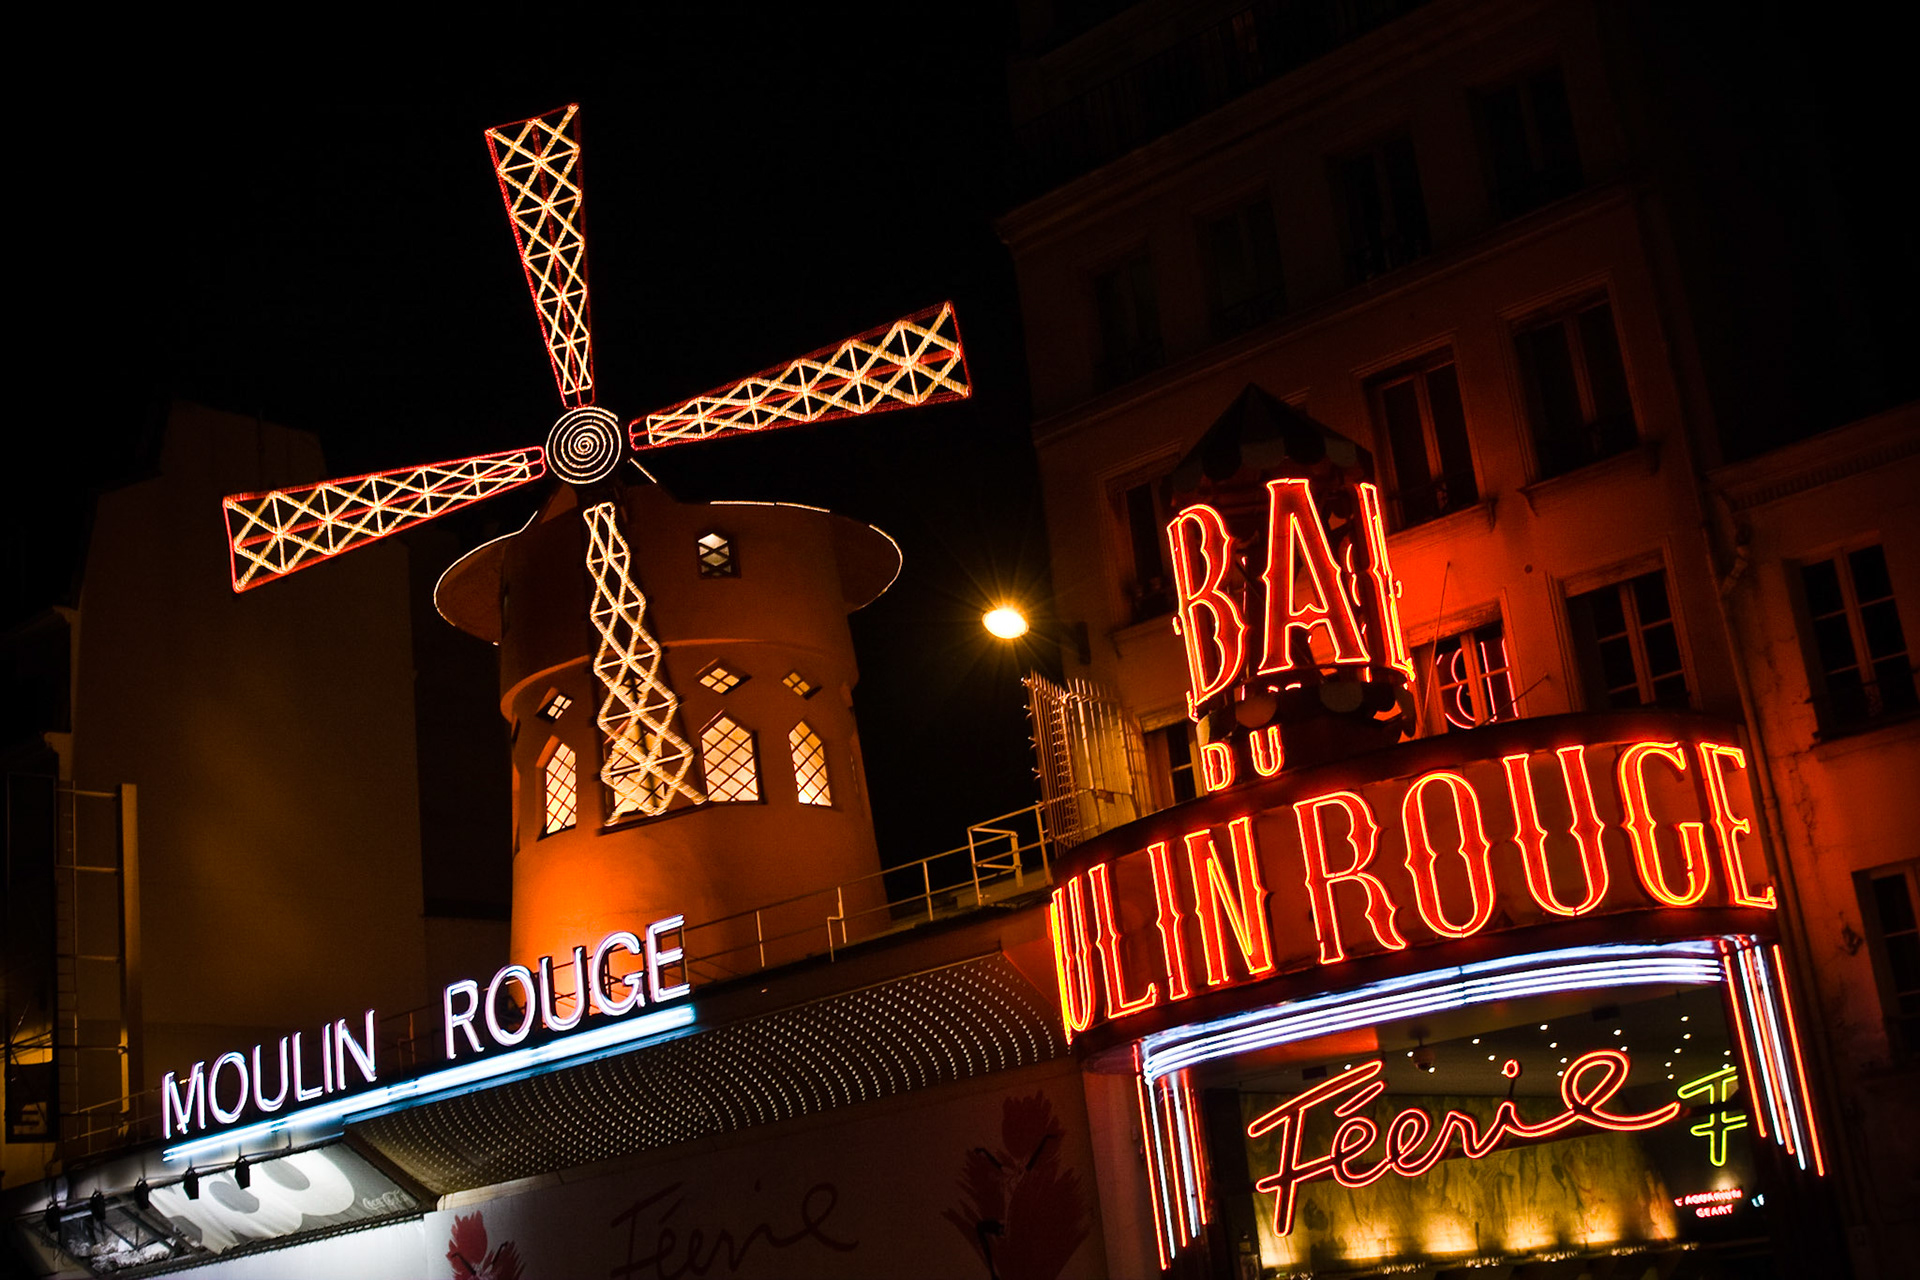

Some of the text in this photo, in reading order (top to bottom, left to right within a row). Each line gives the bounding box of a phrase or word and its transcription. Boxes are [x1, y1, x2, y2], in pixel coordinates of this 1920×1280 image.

[1200, 725, 1285, 792] DU
[1292, 740, 1778, 965] ROUGE
[162, 913, 692, 1140] MOULIN ROUGE
[610, 1181, 859, 1280] Féerie
[1247, 1049, 1681, 1238] Féerie
